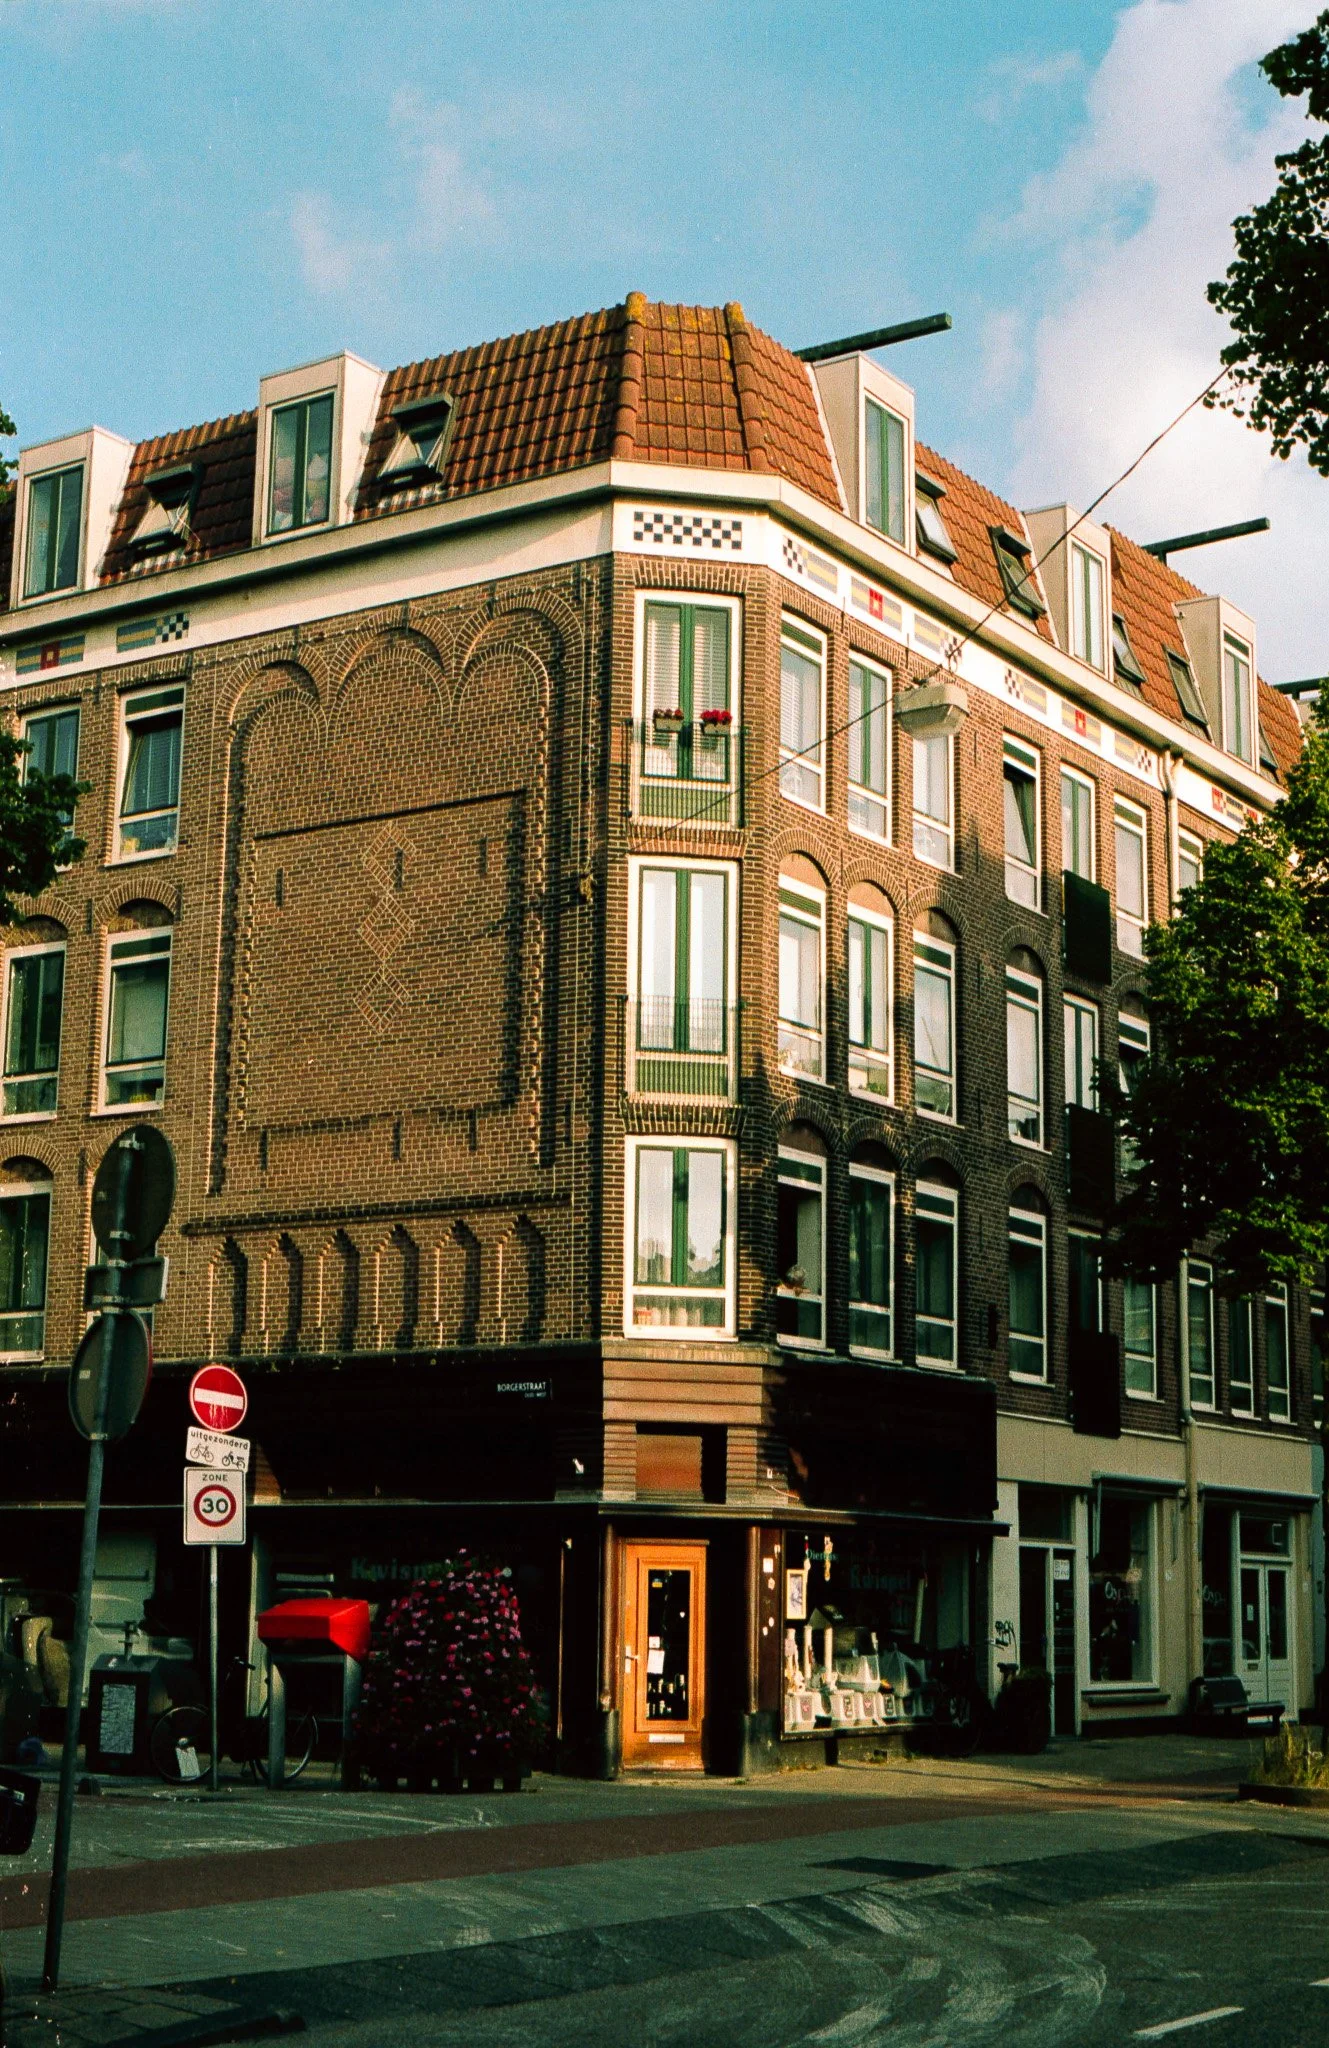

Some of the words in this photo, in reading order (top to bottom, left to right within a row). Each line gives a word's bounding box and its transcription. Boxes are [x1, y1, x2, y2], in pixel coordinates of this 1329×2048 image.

[497, 1382, 546, 1392] BORGERSTRAAT
[190, 1430, 249, 1450] uitgezonderd
[202, 1473, 228, 1481] ZONE
[201, 1497, 229, 1514] 30
